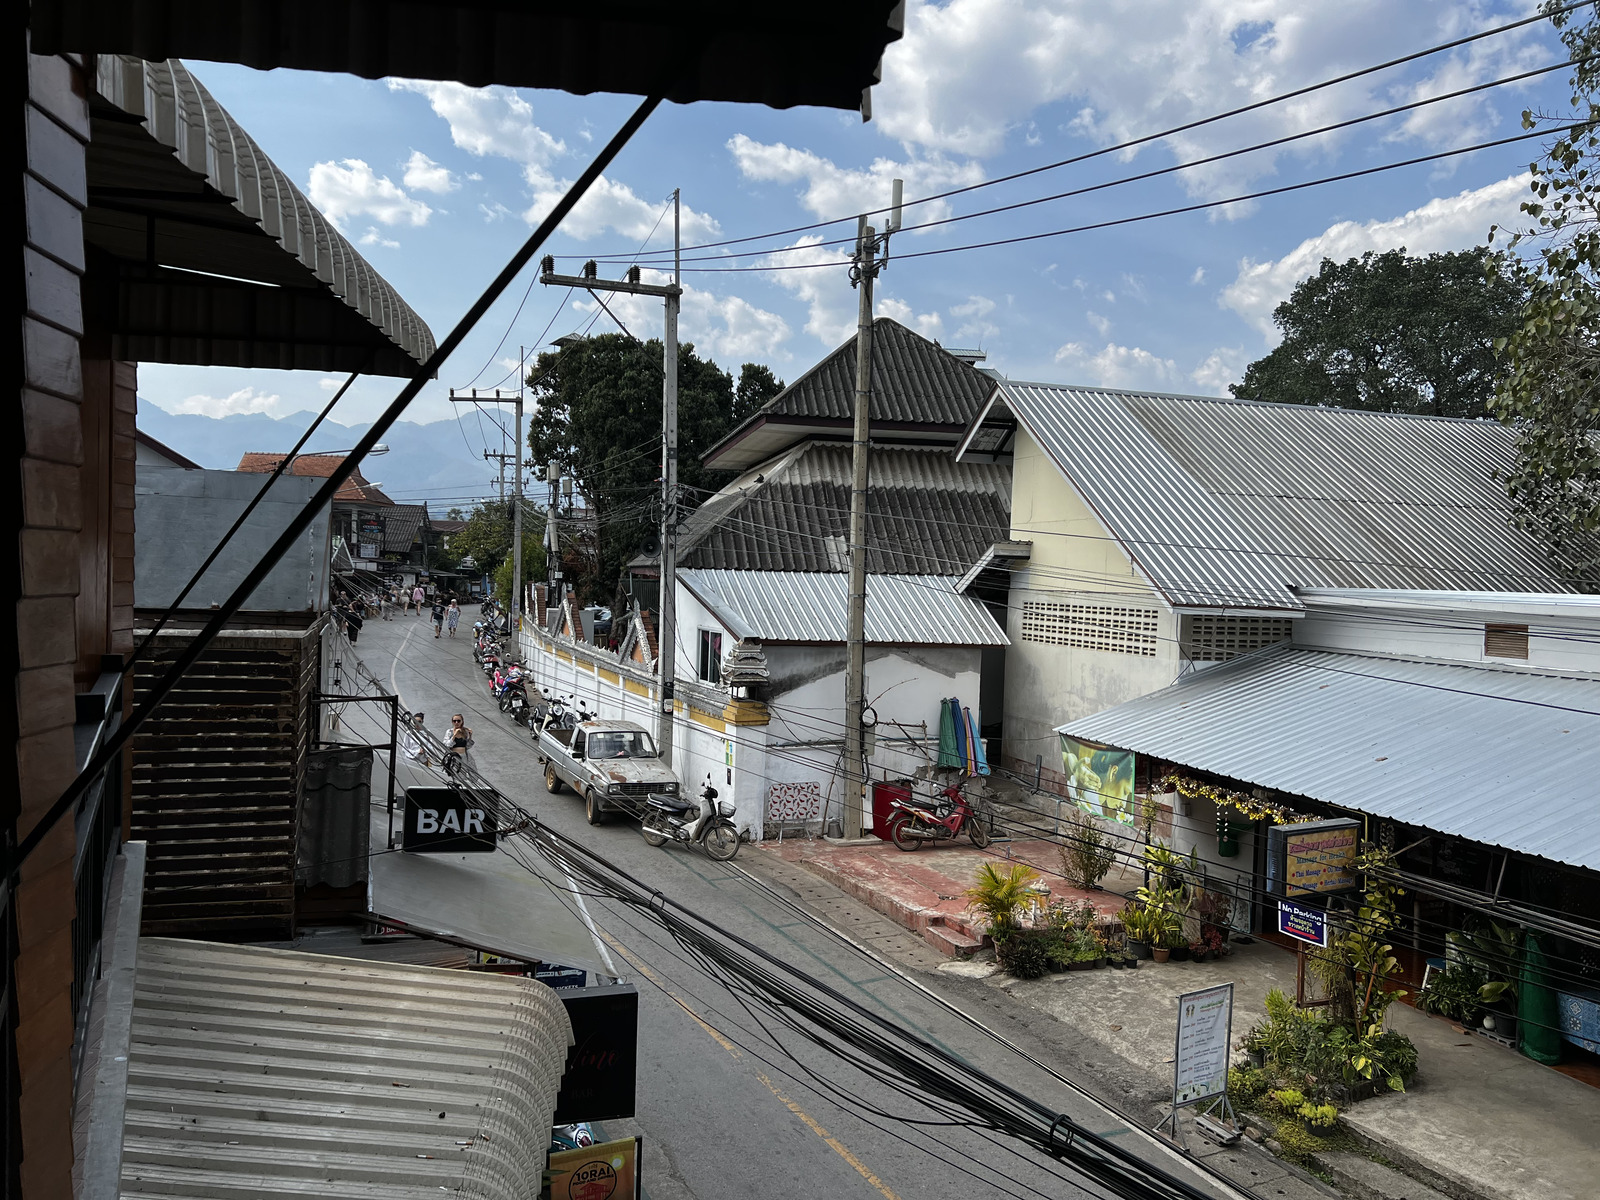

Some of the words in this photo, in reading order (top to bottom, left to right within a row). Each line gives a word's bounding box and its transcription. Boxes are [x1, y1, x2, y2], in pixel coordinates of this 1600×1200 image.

[416, 808, 485, 834] BAR
[1296, 855, 1318, 865] Massage
[1305, 869, 1321, 877] Massage
[1338, 876, 1353, 885] Massage
[1302, 882, 1318, 890] Massage
[1282, 903, 1293, 913] No
[1293, 907, 1322, 926] Parking
[576, 1166, 610, 1181] 10RAI
